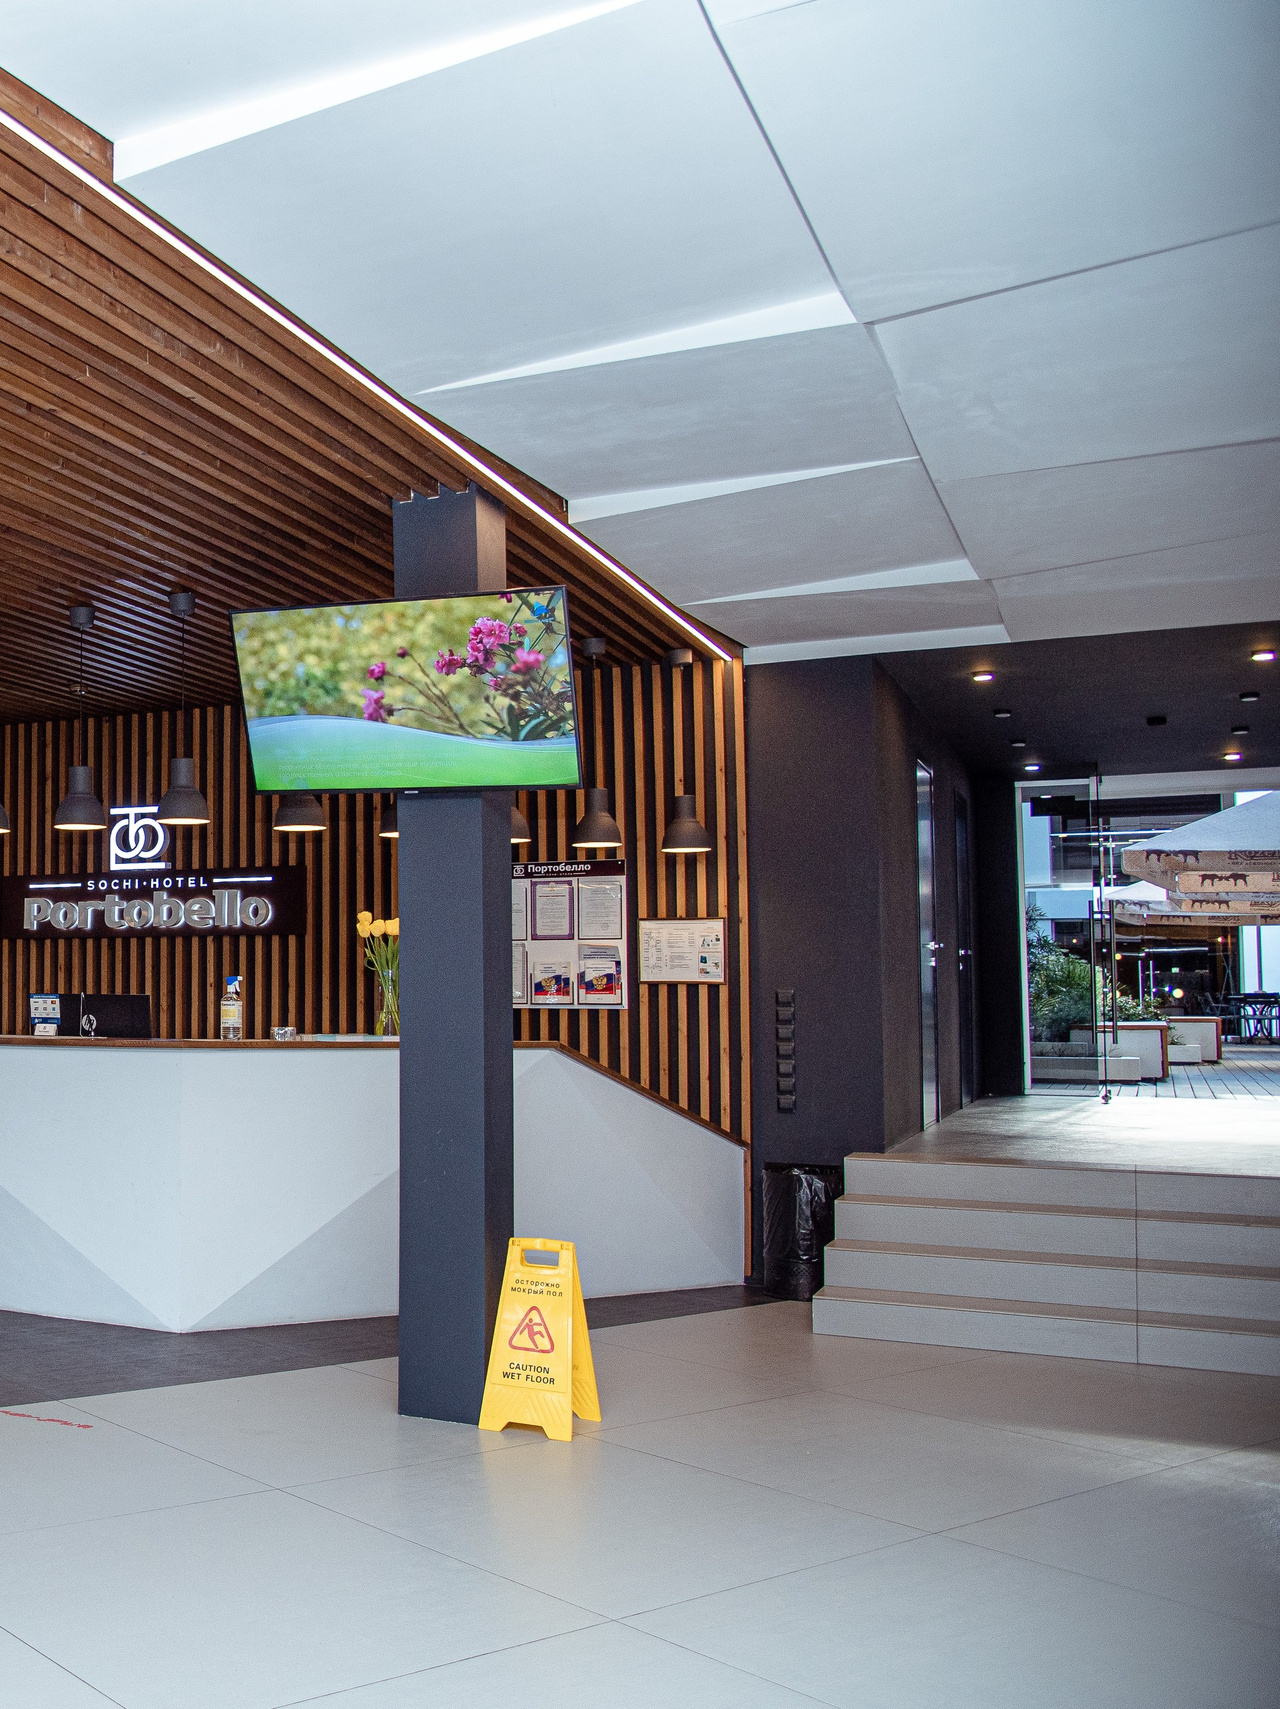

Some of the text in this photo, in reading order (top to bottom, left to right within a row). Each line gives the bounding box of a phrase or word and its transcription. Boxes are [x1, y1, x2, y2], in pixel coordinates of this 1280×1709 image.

[527, 863, 591, 874] Портобелло
[23, 889, 273, 931] Portobello
[515, 1279, 560, 1289] осторожно
[509, 1362, 550, 1374] CAUTION
[502, 1371, 555, 1385] WET FLOOR
